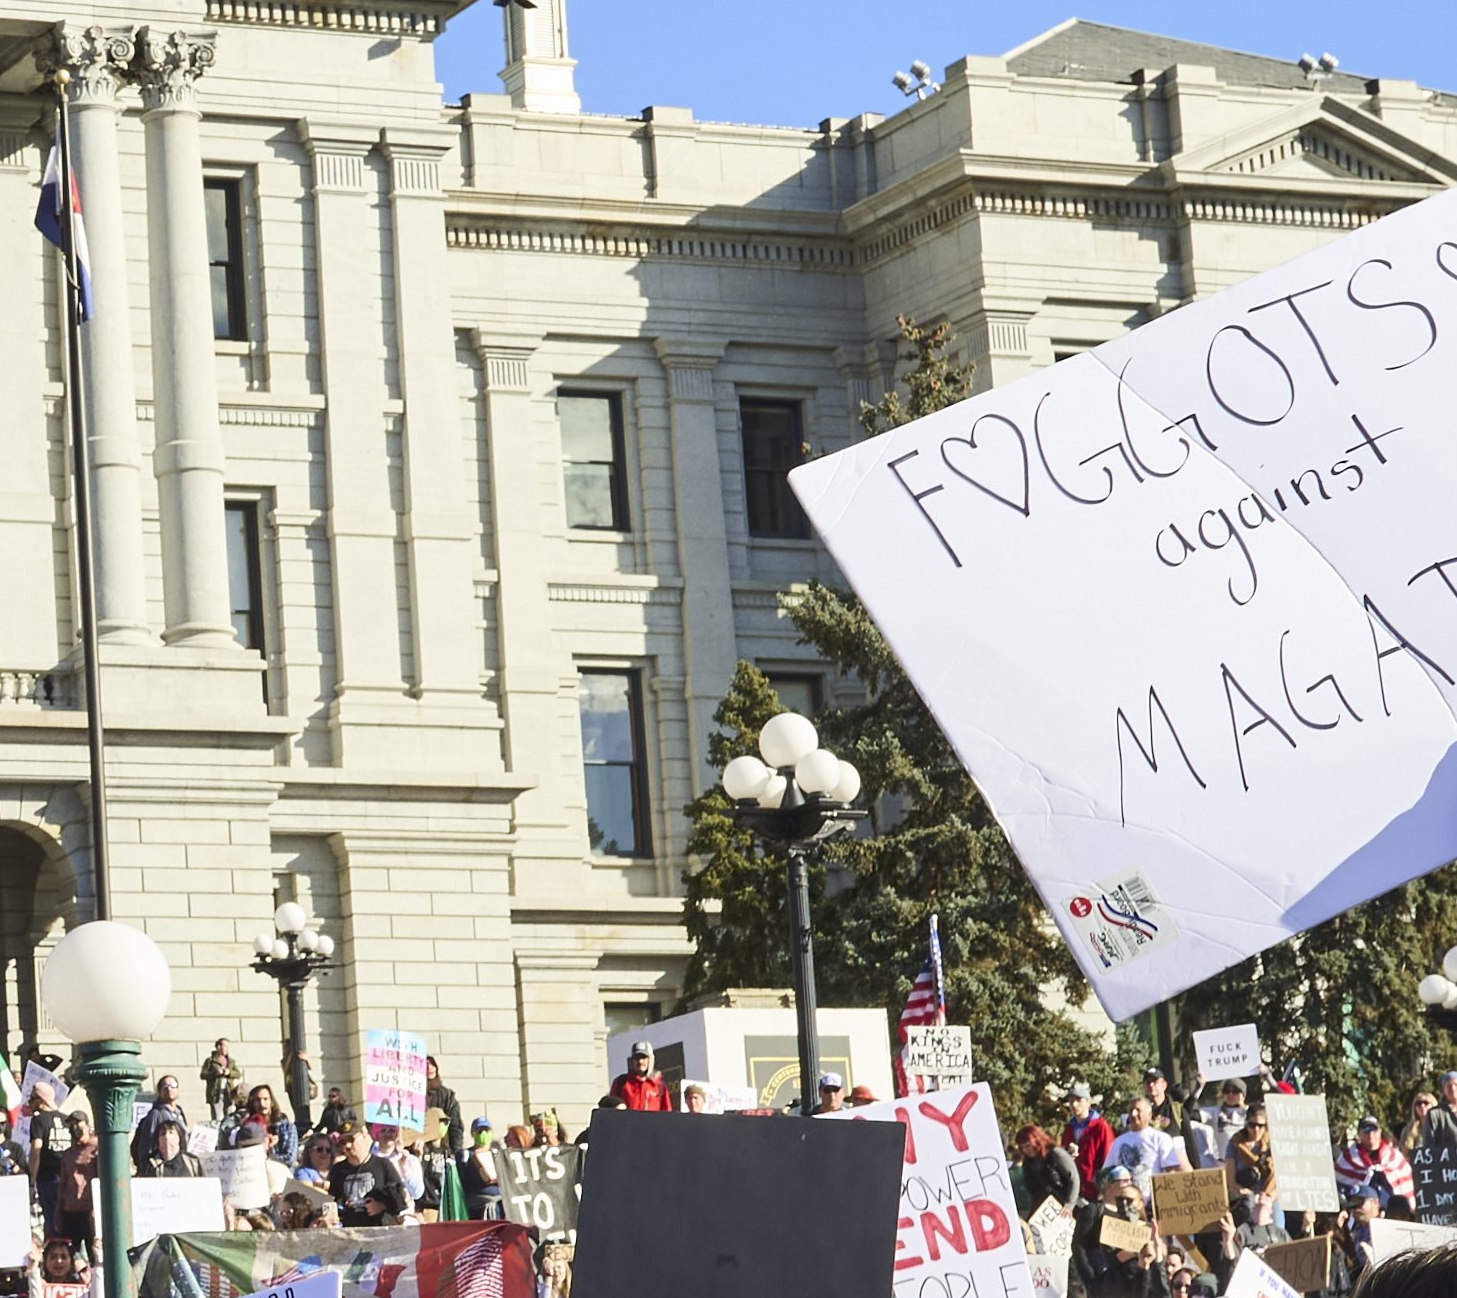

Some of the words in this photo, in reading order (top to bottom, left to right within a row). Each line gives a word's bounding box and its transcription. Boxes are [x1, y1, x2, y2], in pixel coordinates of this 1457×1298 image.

[1154, 413, 1405, 606] against
[925, 1027, 950, 1036] NO
[910, 1035, 962, 1049] KINGS
[1210, 1042, 1242, 1053] FUCK
[372, 1048, 425, 1065] LIBERTY
[909, 1053, 970, 1069] AMERICA
[1207, 1054, 1248, 1067] TRUMP
[388, 1063, 414, 1076] AND
[371, 1072, 423, 1092] JUSTICE
[388, 1088, 414, 1100] FOR
[376, 1099, 419, 1123] ALL
[1414, 1149, 1433, 1164] AS
[1440, 1147, 1449, 1161] A
[509, 1146, 566, 1184] IT'S
[1421, 1169, 1432, 1183] I
[1153, 1176, 1175, 1193] We
[1295, 1190, 1336, 1210] LIES
[1417, 1192, 1430, 1208] 1
[1435, 1193, 1454, 1205] DAY
[511, 1191, 555, 1230] TO
[1421, 1213, 1453, 1225] HAVE
[1105, 1219, 1149, 1240] ABOLISH
[1107, 1233, 1122, 1245] ICE
[1267, 1275, 1280, 1291] YOU
